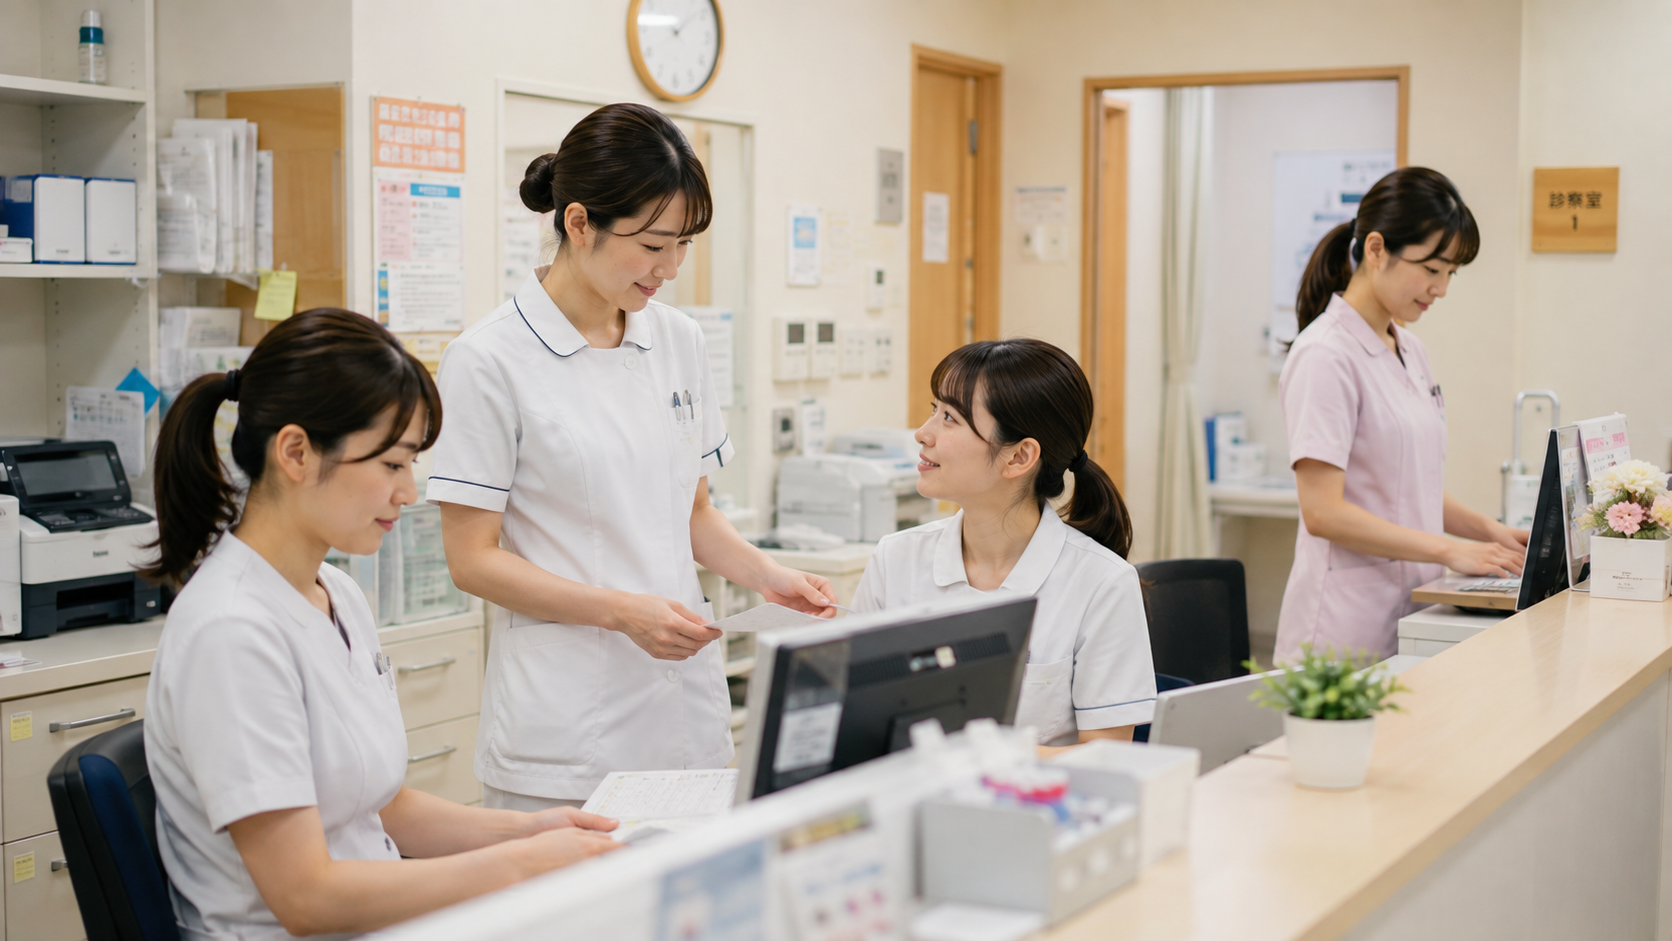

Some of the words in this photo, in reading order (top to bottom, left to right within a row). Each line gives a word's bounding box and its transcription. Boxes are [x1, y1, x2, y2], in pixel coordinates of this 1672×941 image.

[1549, 191, 1603, 209] 診察室
[1572, 214, 1578, 232] 1
